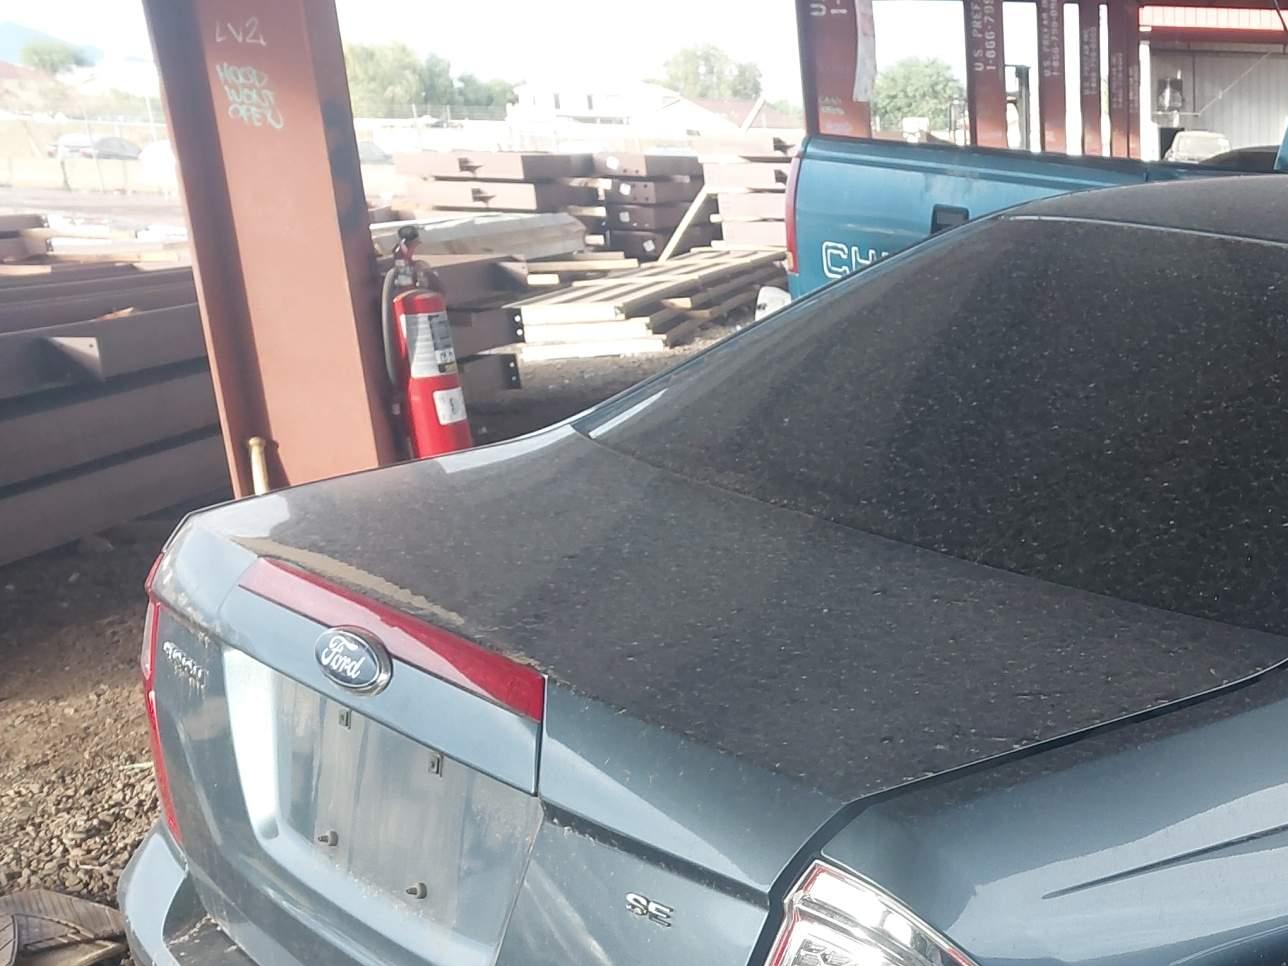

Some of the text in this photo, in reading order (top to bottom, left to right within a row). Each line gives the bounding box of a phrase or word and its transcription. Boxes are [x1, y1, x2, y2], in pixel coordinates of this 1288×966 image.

[215, 62, 268, 88] HOOD
[822, 241, 889, 279] CH
[321, 635, 366, 679] Ford
[625, 892, 674, 928] SE
